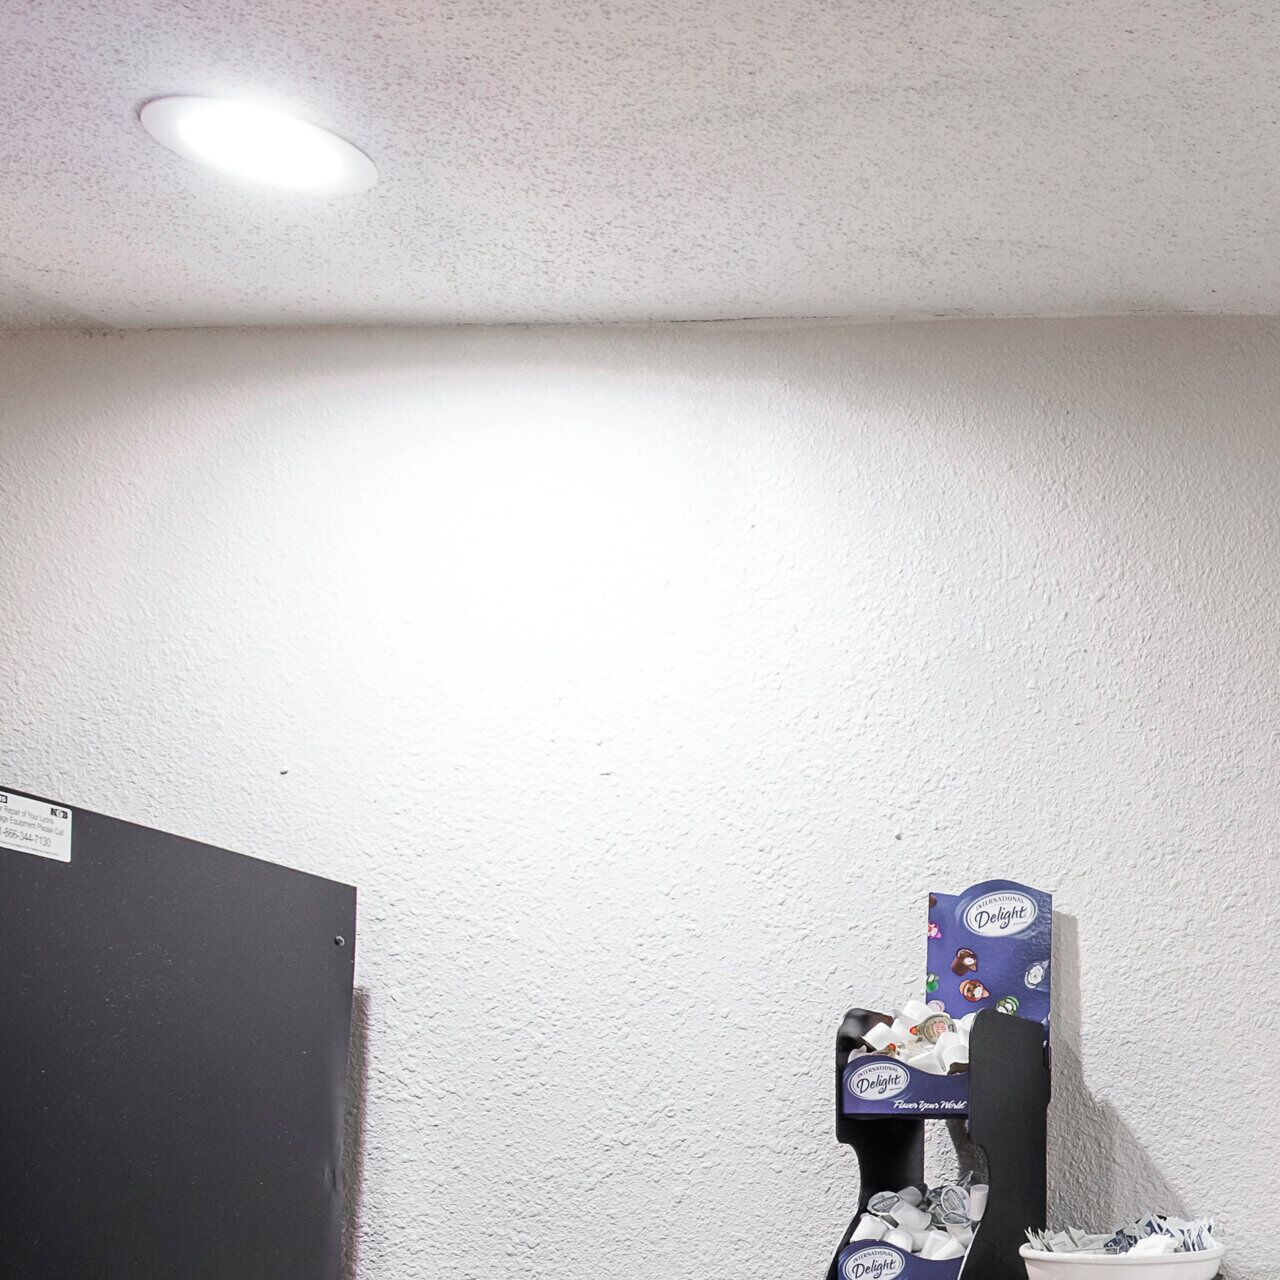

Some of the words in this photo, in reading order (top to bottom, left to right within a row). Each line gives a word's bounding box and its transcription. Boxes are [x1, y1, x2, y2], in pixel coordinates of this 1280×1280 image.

[975, 896, 1024, 911] INTERNATIONAL
[974, 906, 1027, 930] Delight
[857, 1075, 901, 1094] Delight
[919, 1100, 939, 1111] Your
[940, 1100, 968, 1109] World
[852, 1259, 896, 1279] Delight
